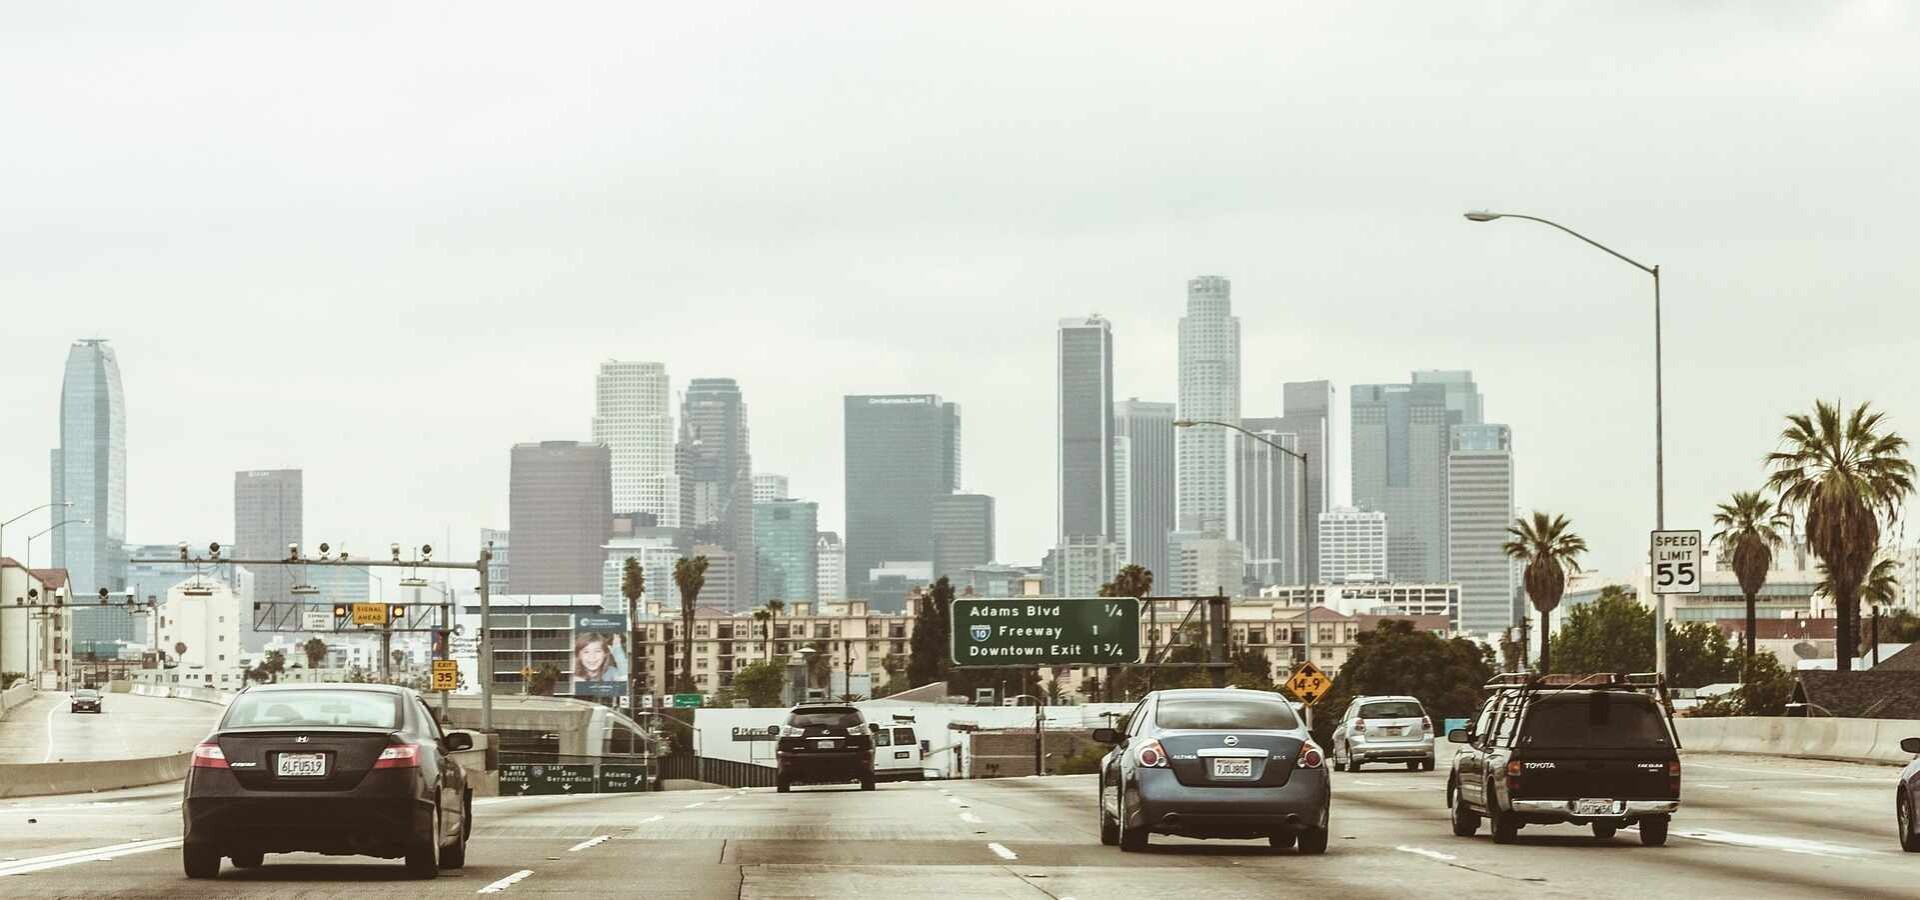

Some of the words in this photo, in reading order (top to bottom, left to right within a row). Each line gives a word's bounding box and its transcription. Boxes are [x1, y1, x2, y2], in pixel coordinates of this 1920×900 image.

[1656, 536, 1697, 547] SPEED
[1660, 550, 1692, 561] LIMIT
[1657, 562, 1695, 586] 55
[969, 606, 1020, 617] Adams
[1026, 606, 1061, 617] Blvd
[1104, 604, 1123, 617] 1/4
[975, 630, 987, 639] 10
[999, 625, 1063, 640] Freeway
[1092, 625, 1099, 636] 1
[969, 646, 1044, 657] Downtown
[1050, 645, 1082, 656] Exit
[1093, 645, 1099, 656] 1
[1104, 644, 1124, 657] 3/4
[437, 672, 453, 682] 35
[282, 761, 323, 774] 6LFU519
[604, 771, 632, 779] Adams
[608, 780, 628, 788] Blvd
